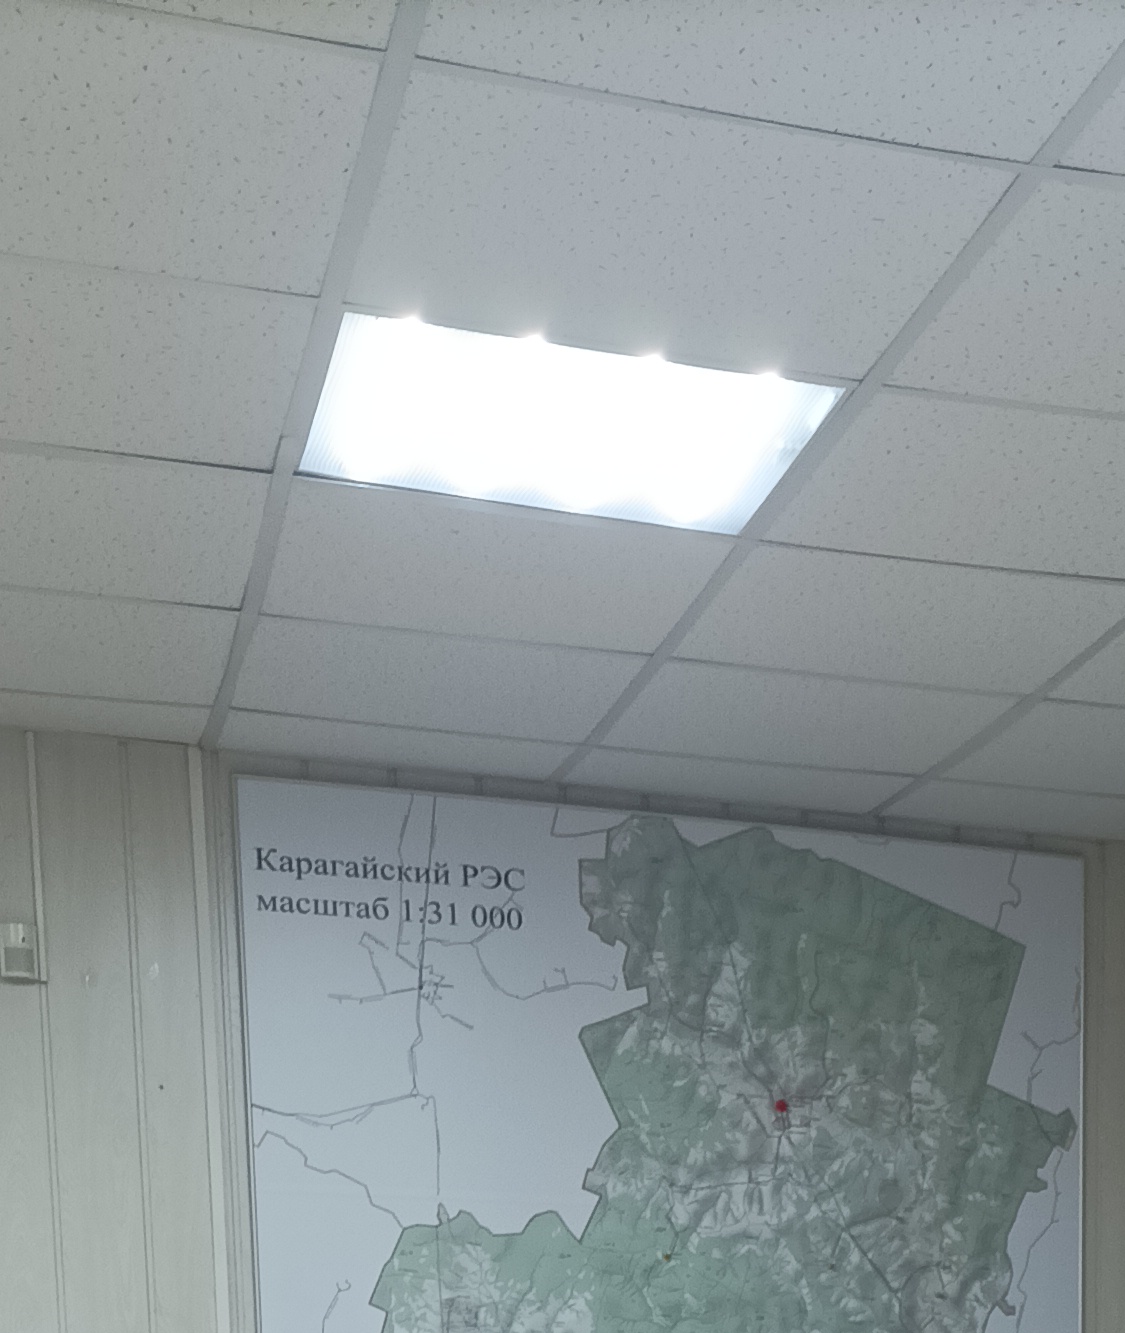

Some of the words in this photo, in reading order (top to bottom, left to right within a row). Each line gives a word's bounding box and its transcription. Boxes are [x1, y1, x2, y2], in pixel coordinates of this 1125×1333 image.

[254, 847, 451, 886] Карагайский
[461, 863, 526, 892] РЭС
[256, 894, 389, 921] масштаб
[402, 898, 458, 926] 1:31
[470, 904, 523, 930] 000
